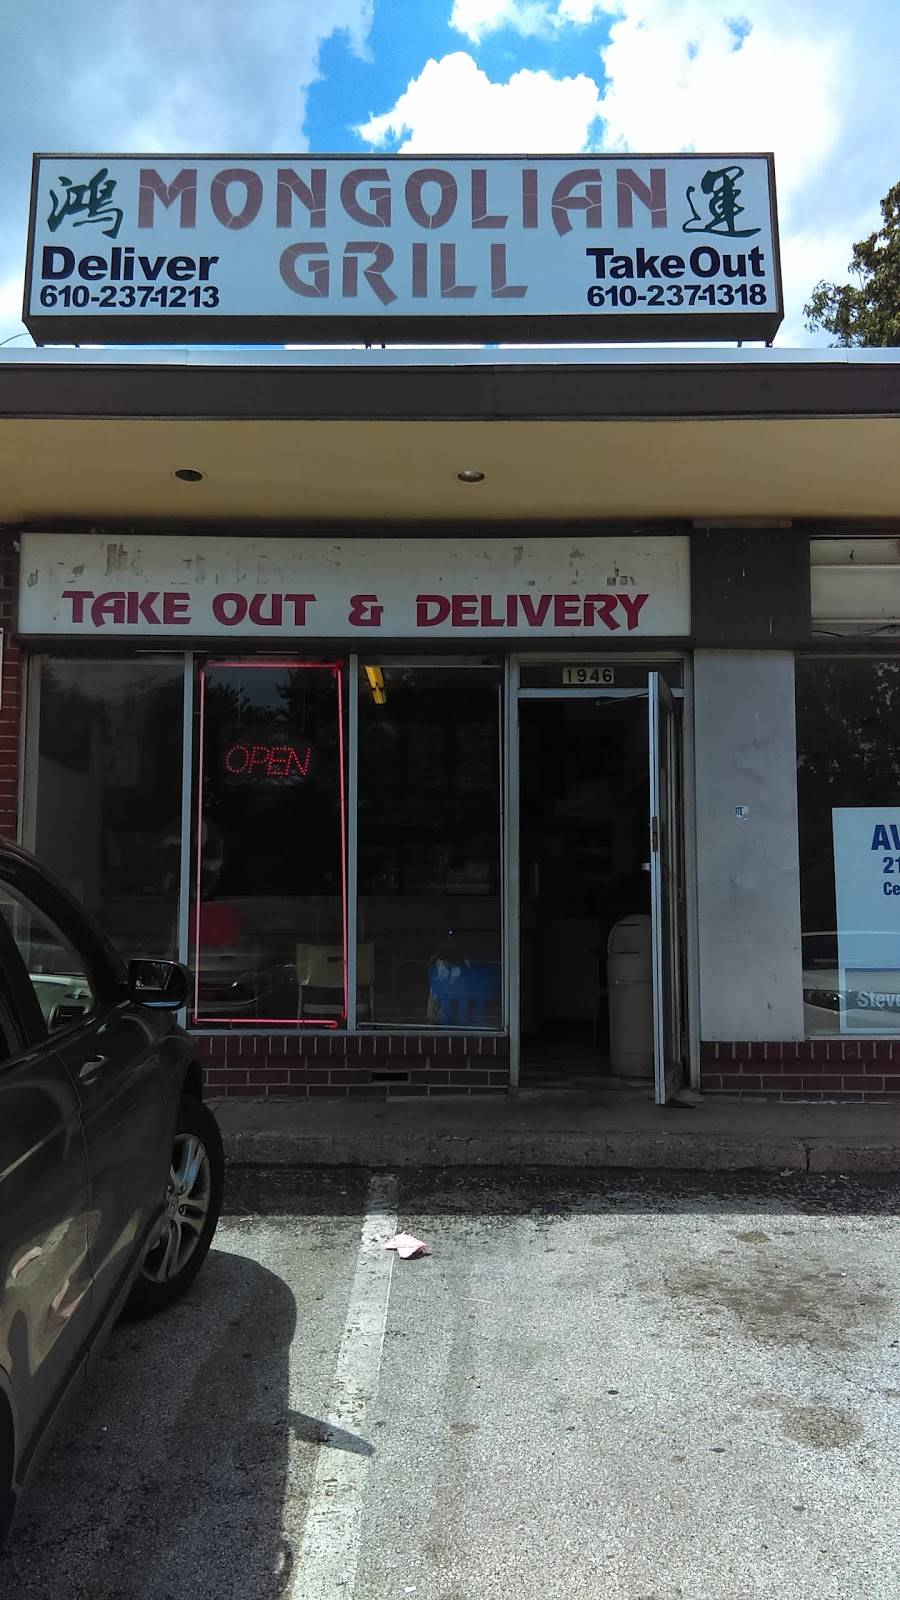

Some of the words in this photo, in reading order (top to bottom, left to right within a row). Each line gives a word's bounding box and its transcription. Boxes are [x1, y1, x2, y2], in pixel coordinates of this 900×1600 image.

[137, 168, 667, 237] MONGOLIAN
[41, 246, 219, 281] Deliver
[279, 241, 528, 306] GRILL
[40, 285, 220, 308] 610-237-1213
[587, 284, 767, 307] 610-237-1318
[61, 591, 192, 627] TAKE
[212, 593, 317, 626] OUT
[348, 594, 384, 627] &
[416, 593, 650, 631] DELIVERY
[567, 669, 613, 683] 1946
[225, 745, 312, 777] OPEN
